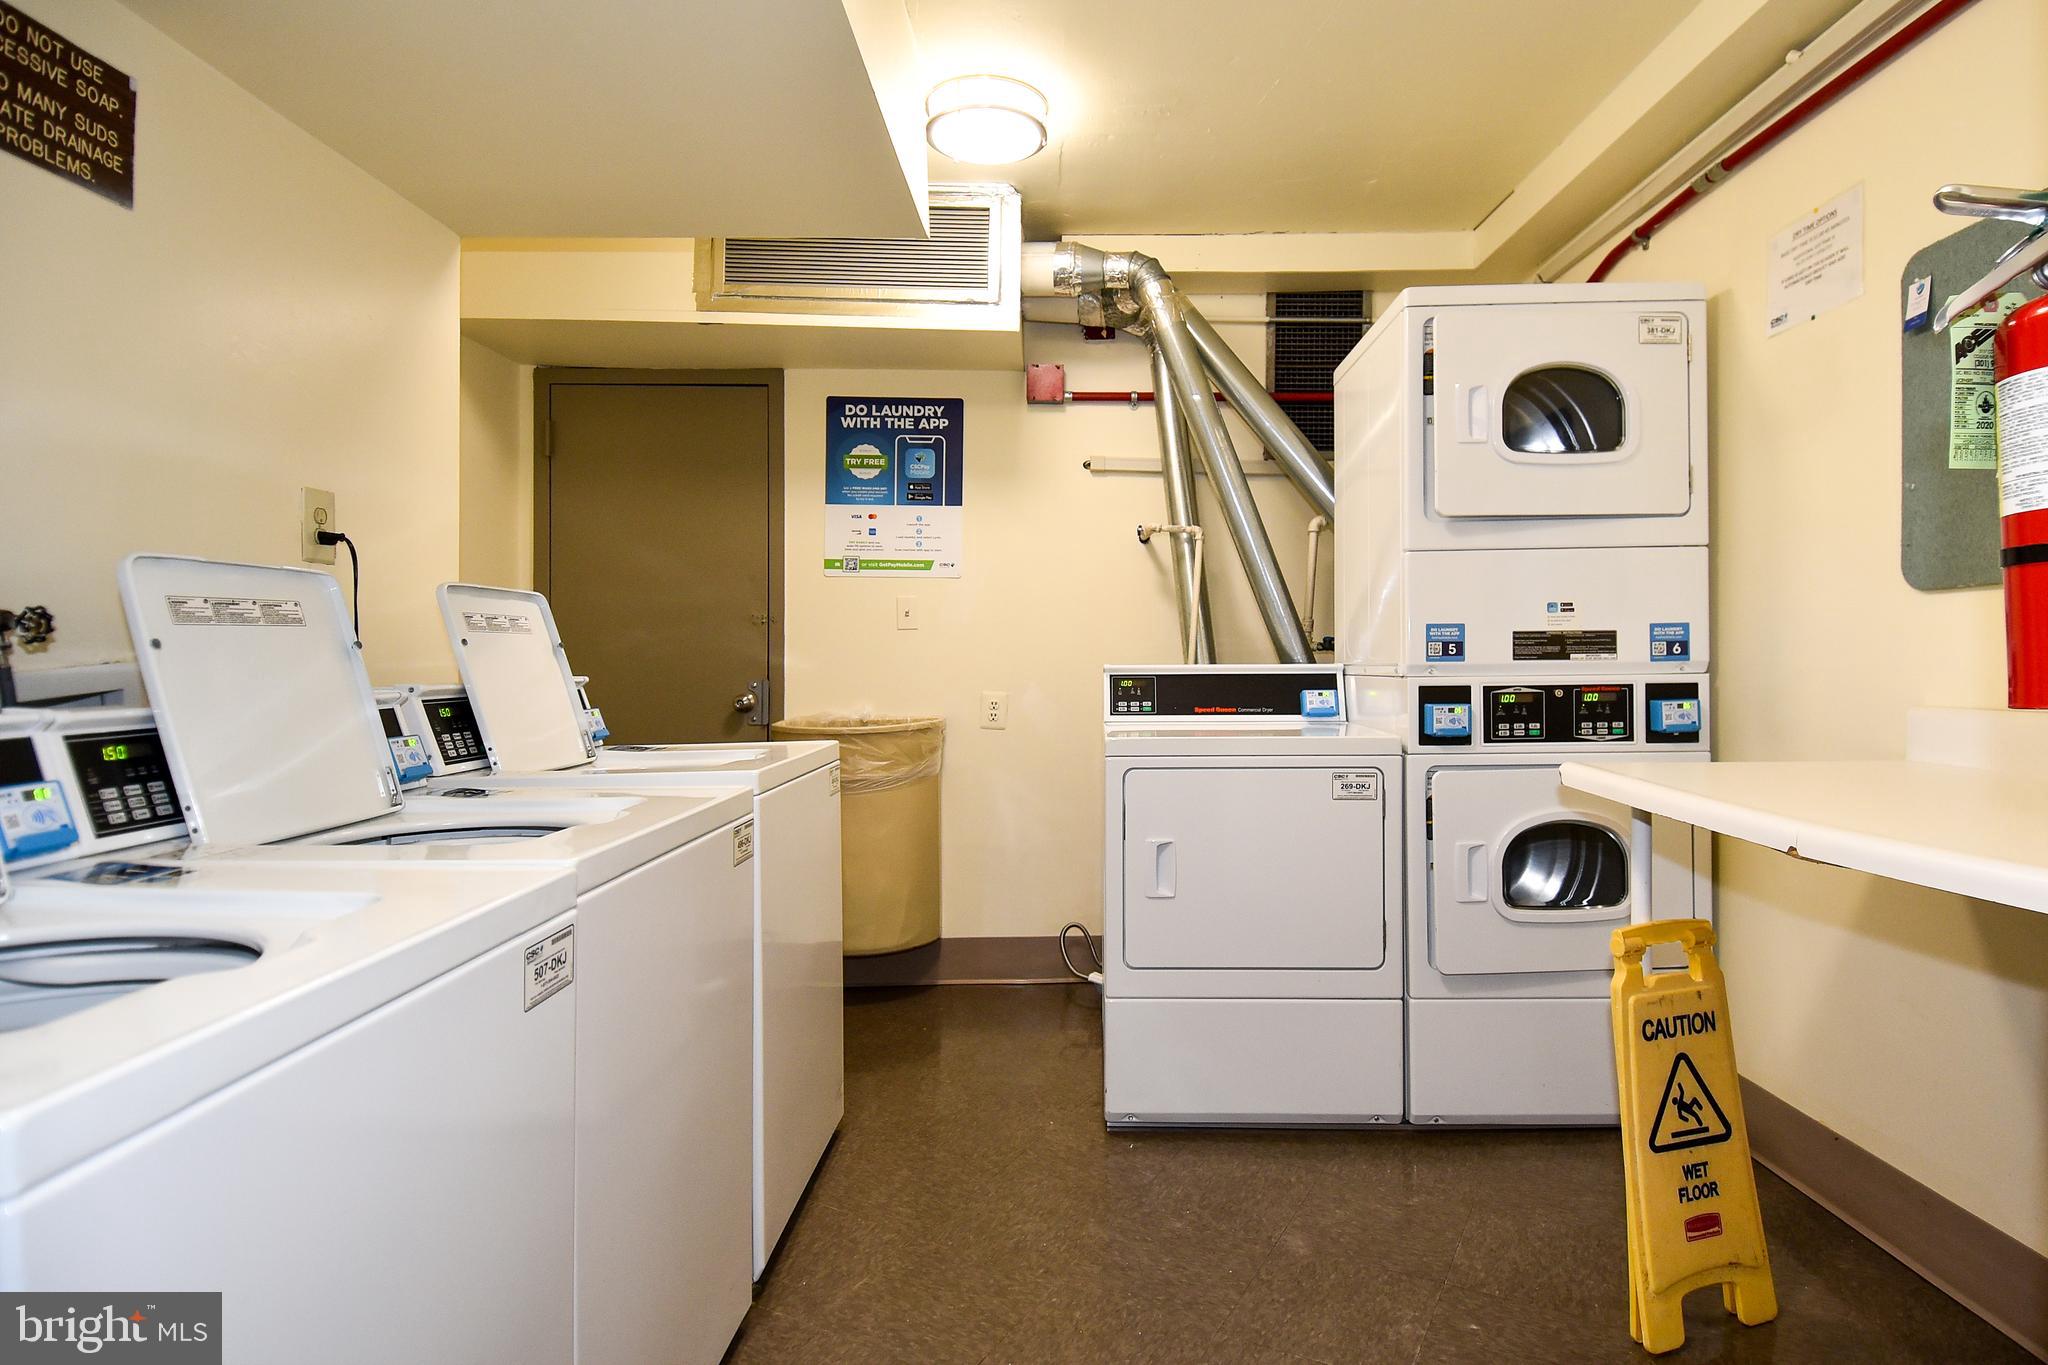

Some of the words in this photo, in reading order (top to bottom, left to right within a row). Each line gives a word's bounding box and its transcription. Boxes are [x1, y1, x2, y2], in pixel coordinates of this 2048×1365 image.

[27, 26, 64, 59] NOT
[70, 52, 104, 85] USE
[75, 80, 124, 119] SOAP.
[17, 82, 67, 120] MANY
[75, 113, 119, 148] SUDS
[43, 120, 124, 174] DRAINAGE
[845, 404, 867, 416] DO
[871, 405, 945, 417] LAUNDRY
[841, 416, 880, 429] WITH
[885, 417, 914, 429] THE
[918, 418, 949, 430] APP
[1976, 421, 1994, 430] 2020
[845, 458, 862, 466] TRY
[864, 458, 885, 466] FREE
[1448, 643, 1457, 655] 5
[1672, 642, 1682, 655] 6
[534, 951, 567, 982] 507-DKJ
[1641, 1011, 1716, 1042] CAUTION
[1682, 1161, 1709, 1181] WET
[1678, 1181, 1719, 1204] FLOOR
